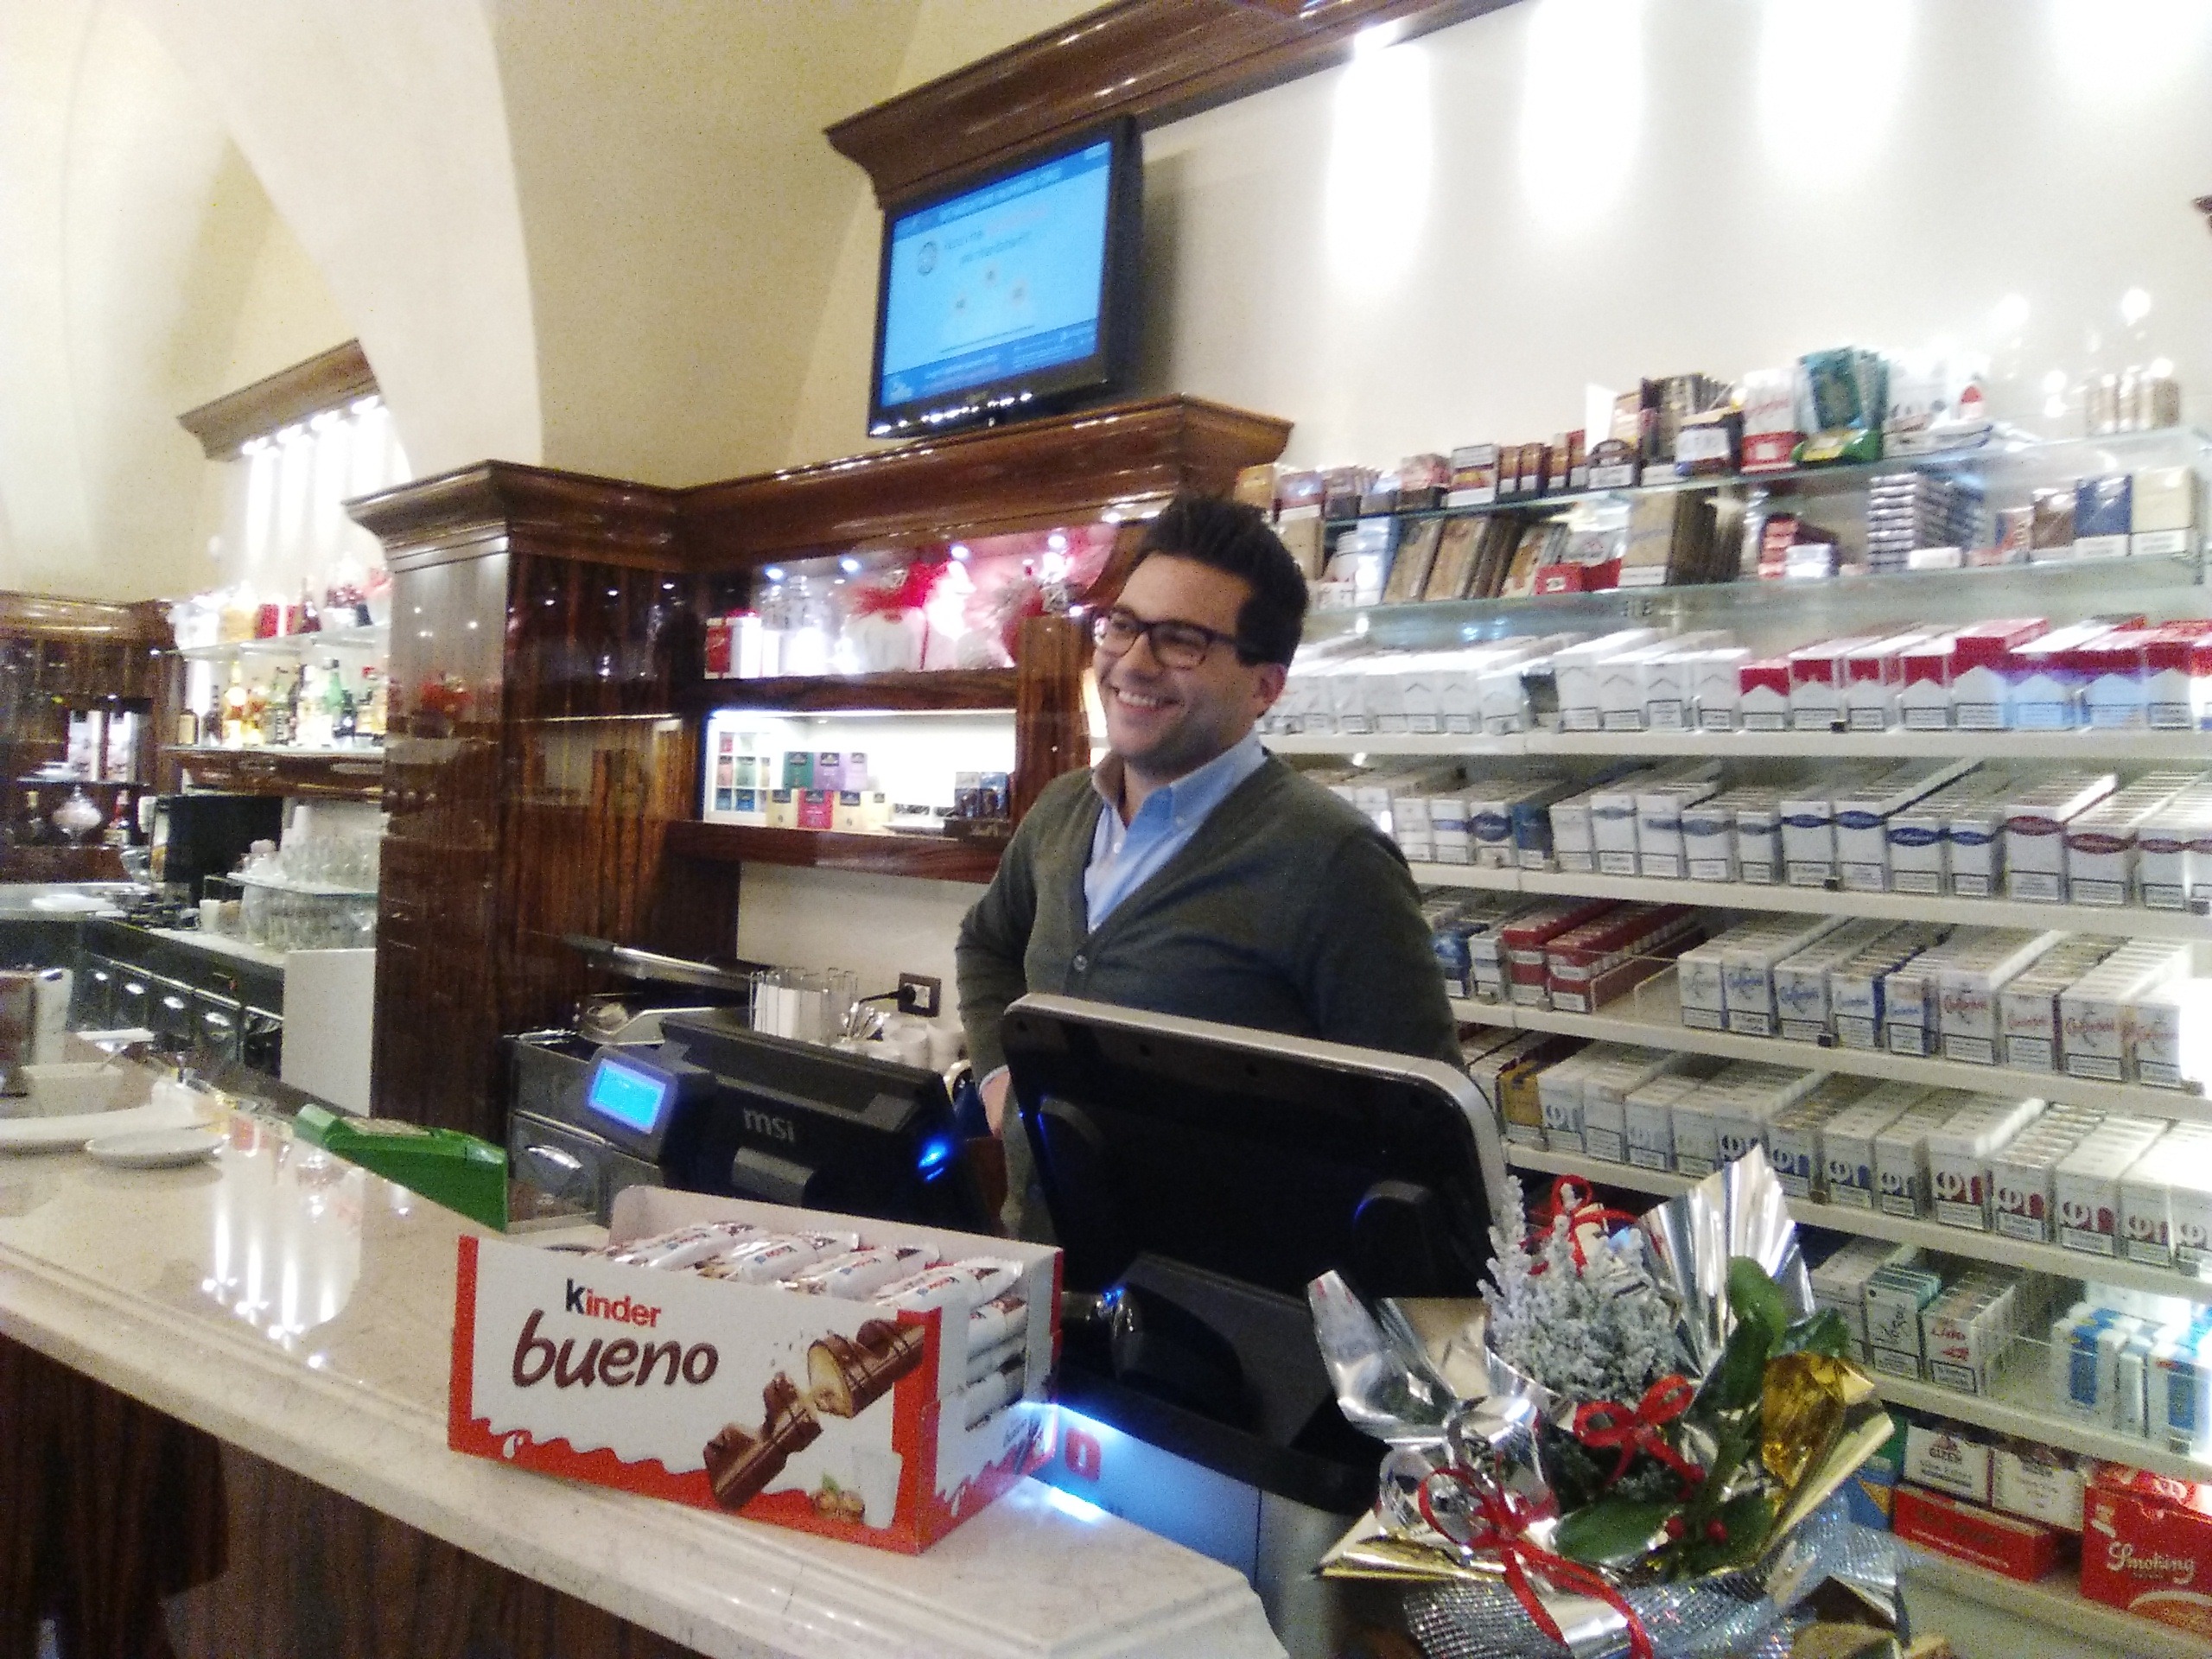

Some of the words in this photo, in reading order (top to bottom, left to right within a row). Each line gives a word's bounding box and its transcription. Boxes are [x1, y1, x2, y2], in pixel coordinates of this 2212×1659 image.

[743, 1109, 795, 1142] msi
[512, 1309, 719, 1388] bueno
[2106, 1541, 2196, 1586] Smoking
